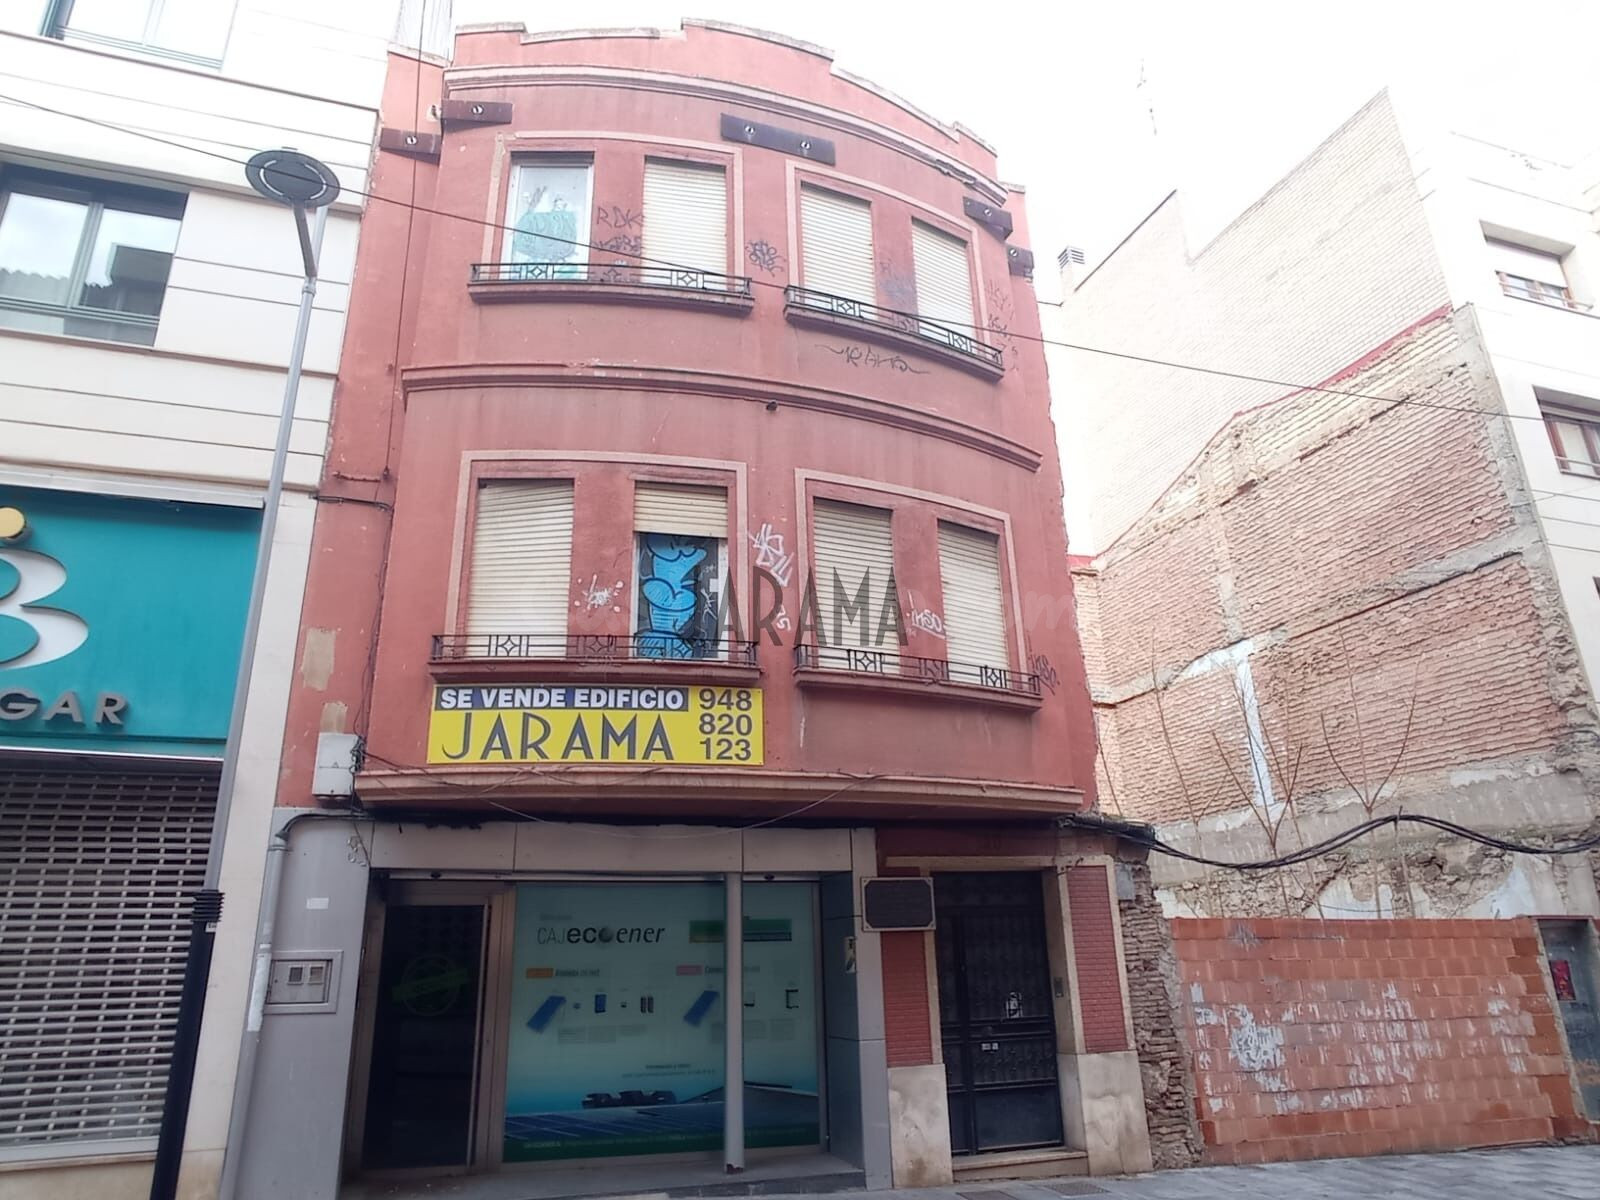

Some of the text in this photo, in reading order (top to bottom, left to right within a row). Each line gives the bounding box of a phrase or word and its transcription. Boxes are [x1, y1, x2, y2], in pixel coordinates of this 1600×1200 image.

[440, 688, 684, 711] SE VENDE EDIFICIO
[699, 688, 753, 711] 948
[441, 712, 675, 760] JARAMA
[699, 713, 753, 736] 820
[699, 738, 752, 761] 123
